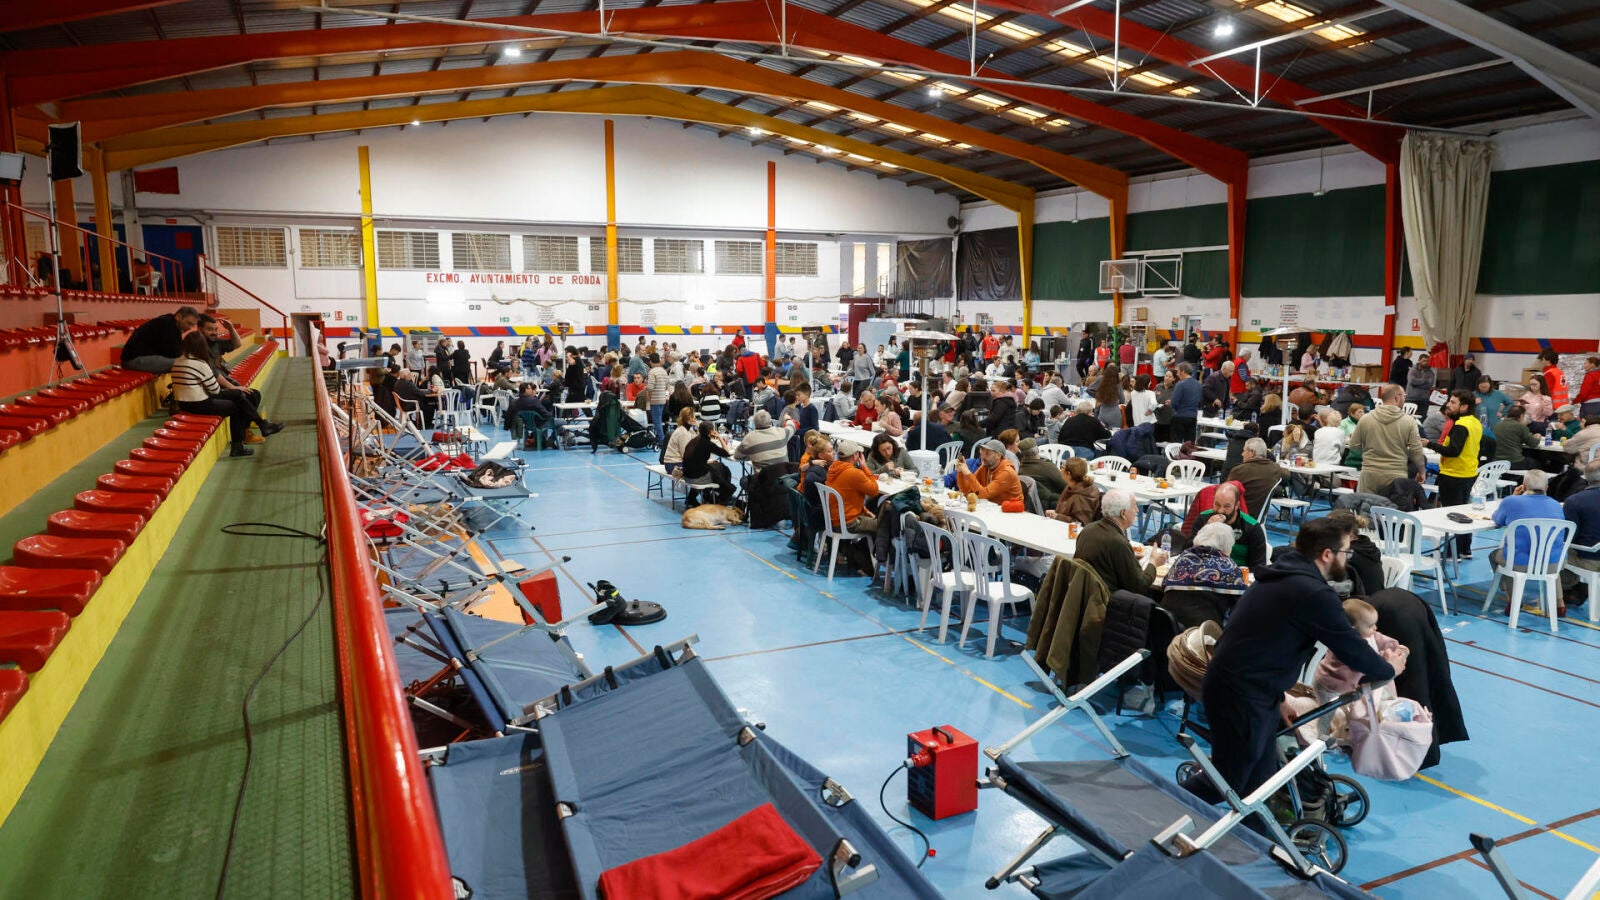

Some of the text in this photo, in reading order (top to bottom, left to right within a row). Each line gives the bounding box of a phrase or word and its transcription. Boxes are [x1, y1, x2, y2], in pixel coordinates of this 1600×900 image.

[426, 273, 601, 285] EXCMO. AYUNTAMIENTO DE RONDA
